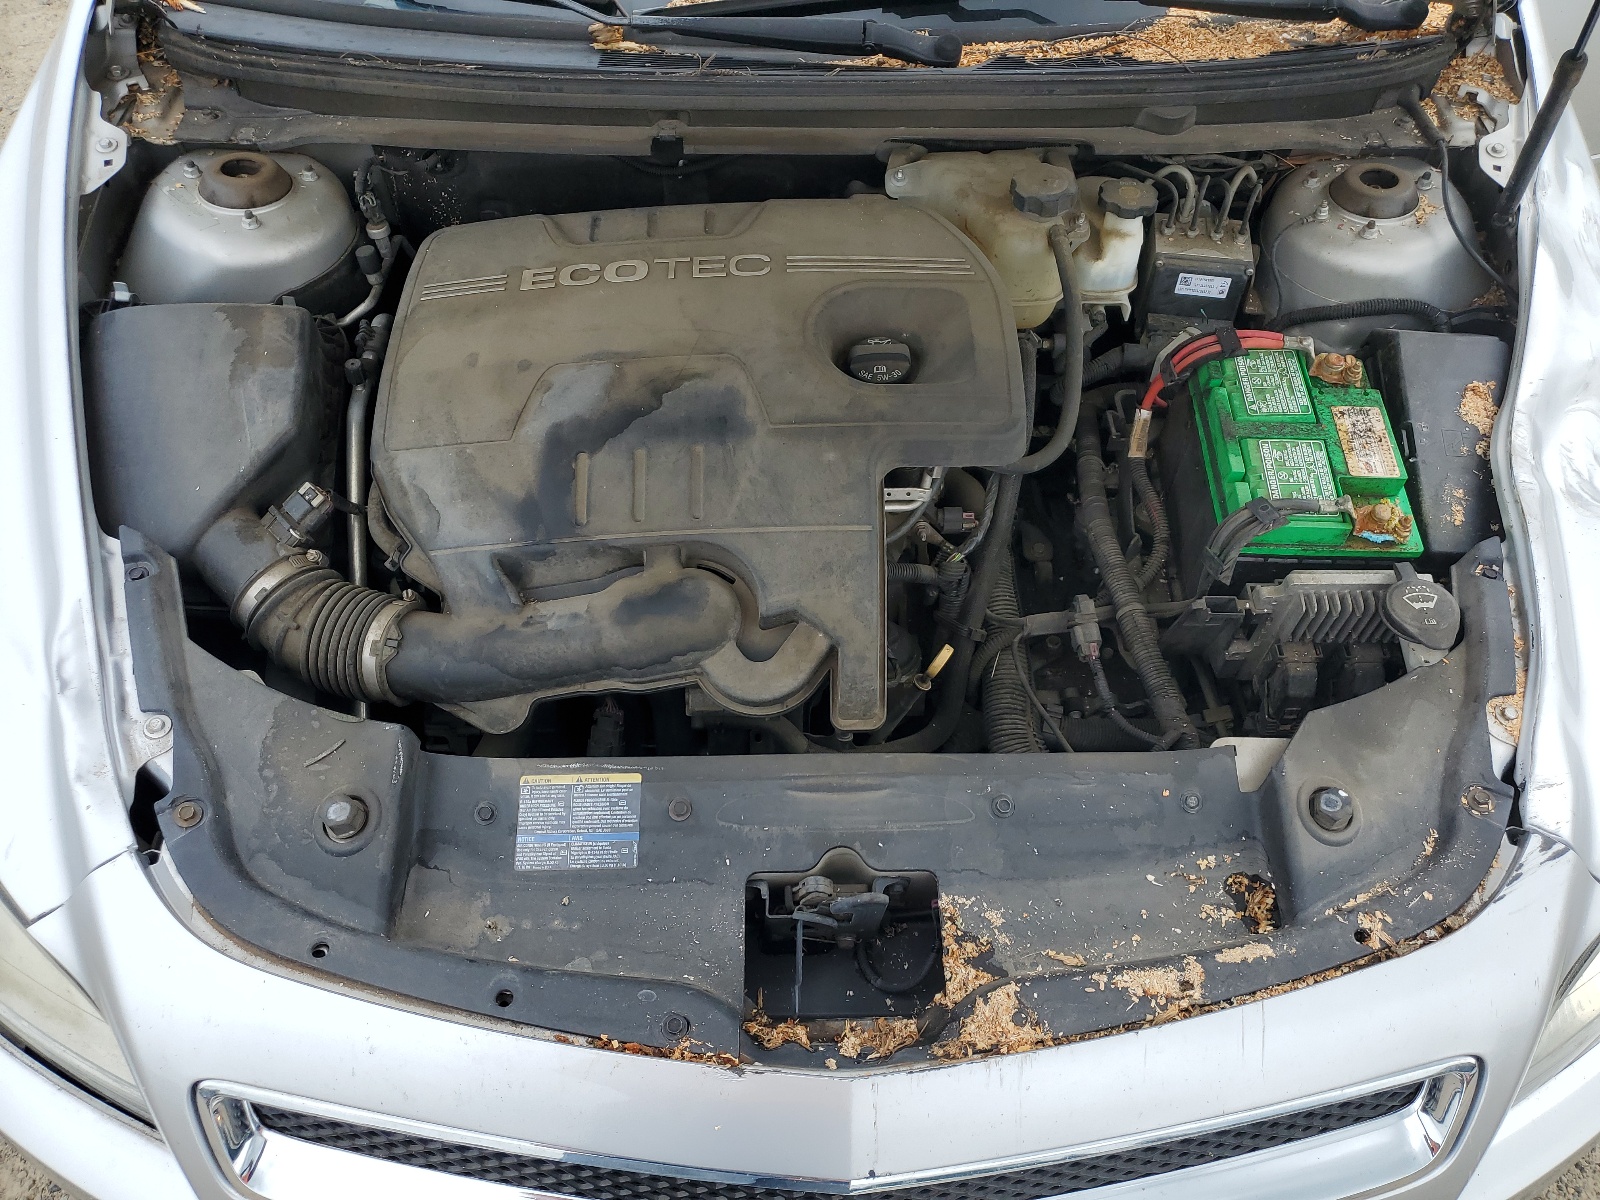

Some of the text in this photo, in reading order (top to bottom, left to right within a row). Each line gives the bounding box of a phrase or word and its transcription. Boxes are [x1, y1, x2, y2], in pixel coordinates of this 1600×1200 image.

[519, 253, 771, 291] ECOTEC
[858, 369, 902, 381] SAE 5W-30
